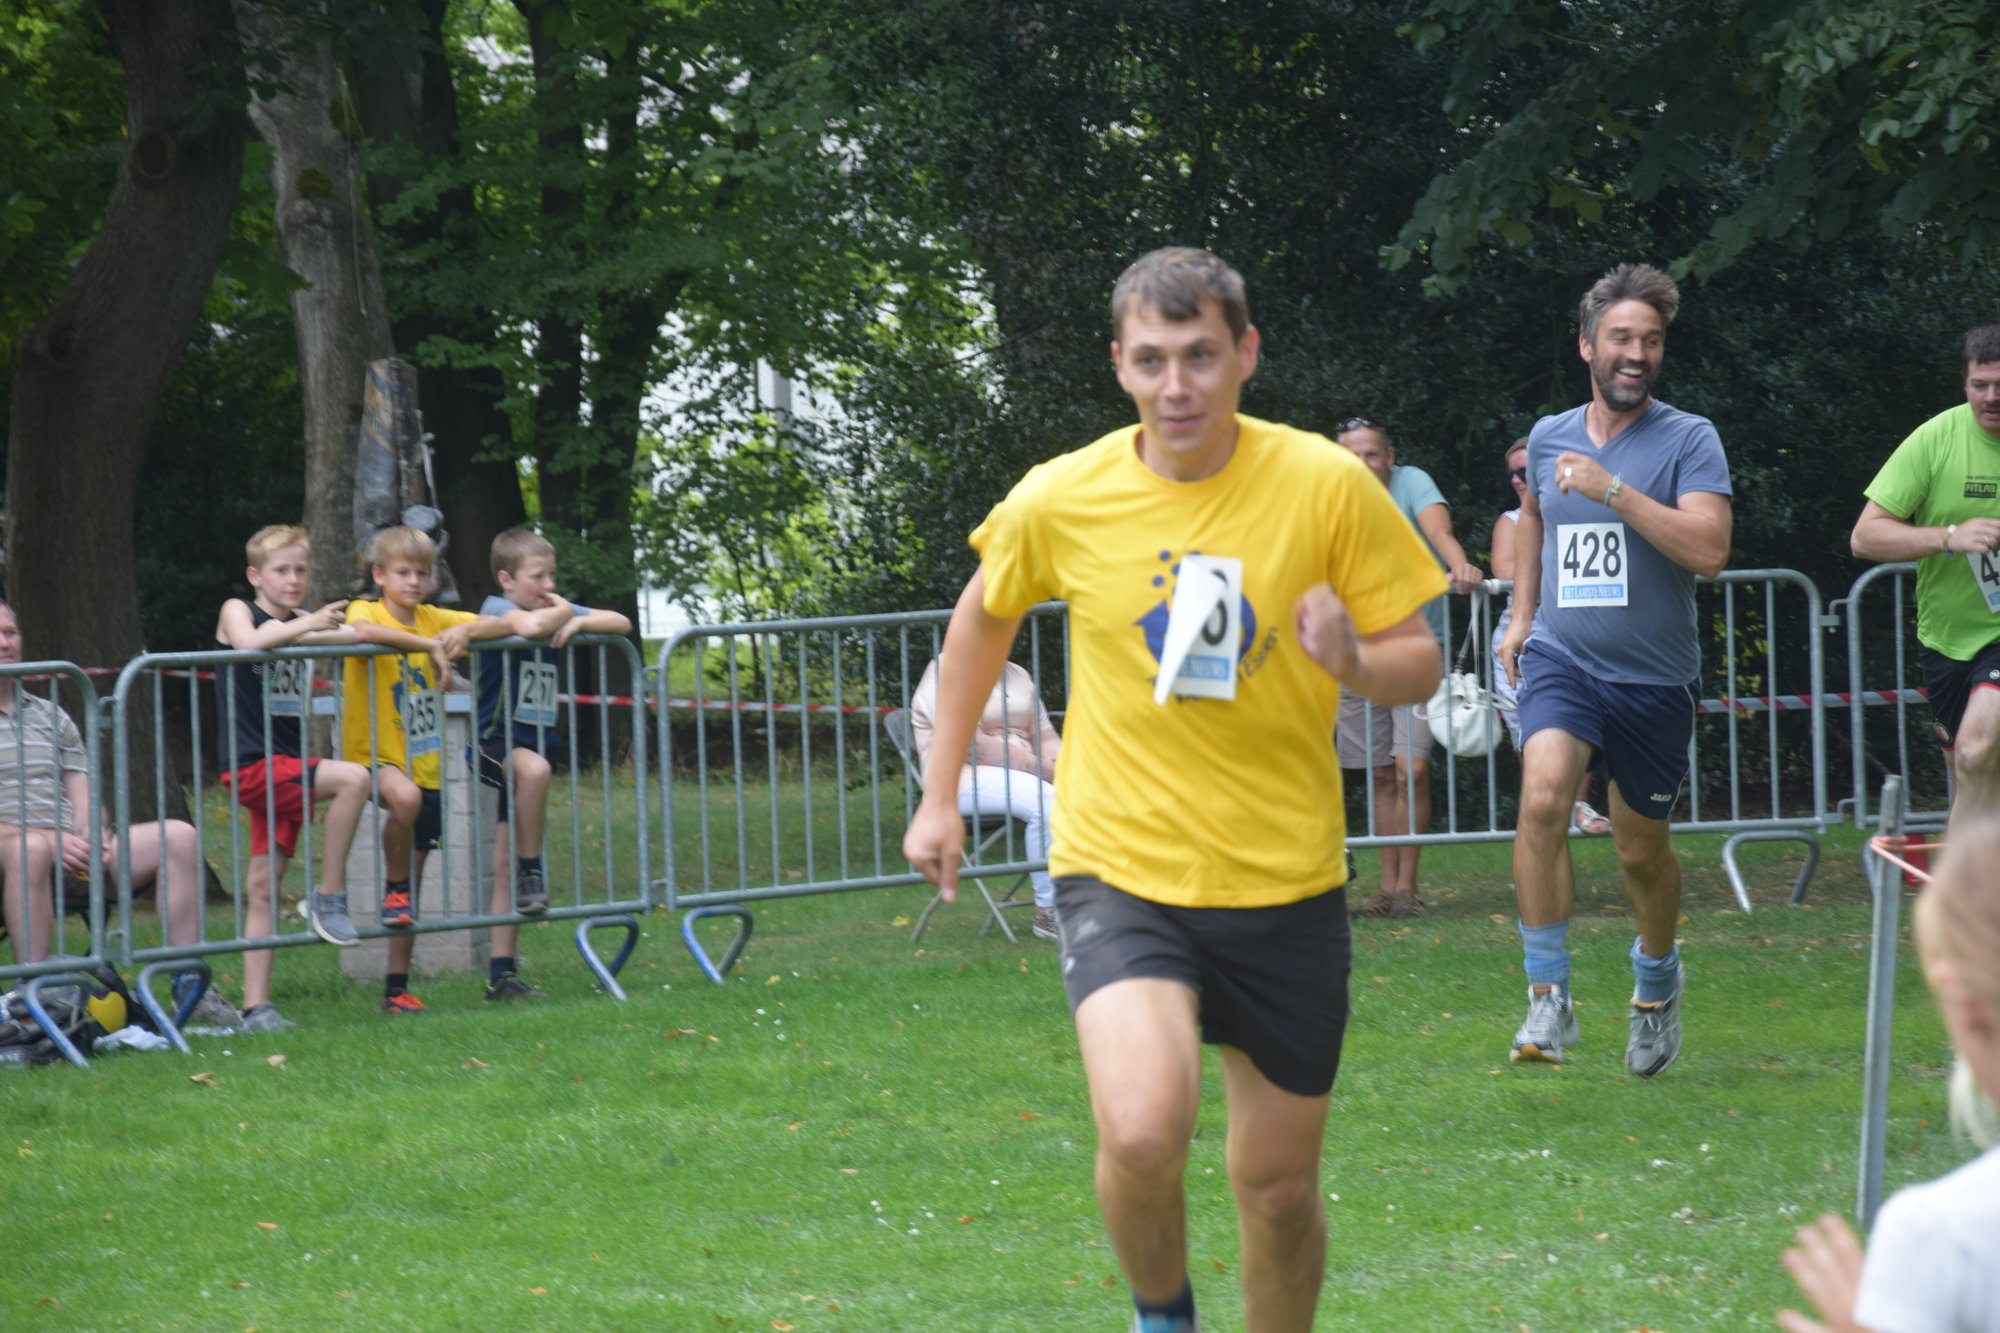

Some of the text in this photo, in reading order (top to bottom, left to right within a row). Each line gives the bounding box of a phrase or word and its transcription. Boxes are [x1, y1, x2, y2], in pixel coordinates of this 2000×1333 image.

[1966, 483, 1996, 493] FITLAB
[1563, 530, 1622, 579] 428
[523, 668, 554, 707] 257
[407, 695, 435, 736] 255
